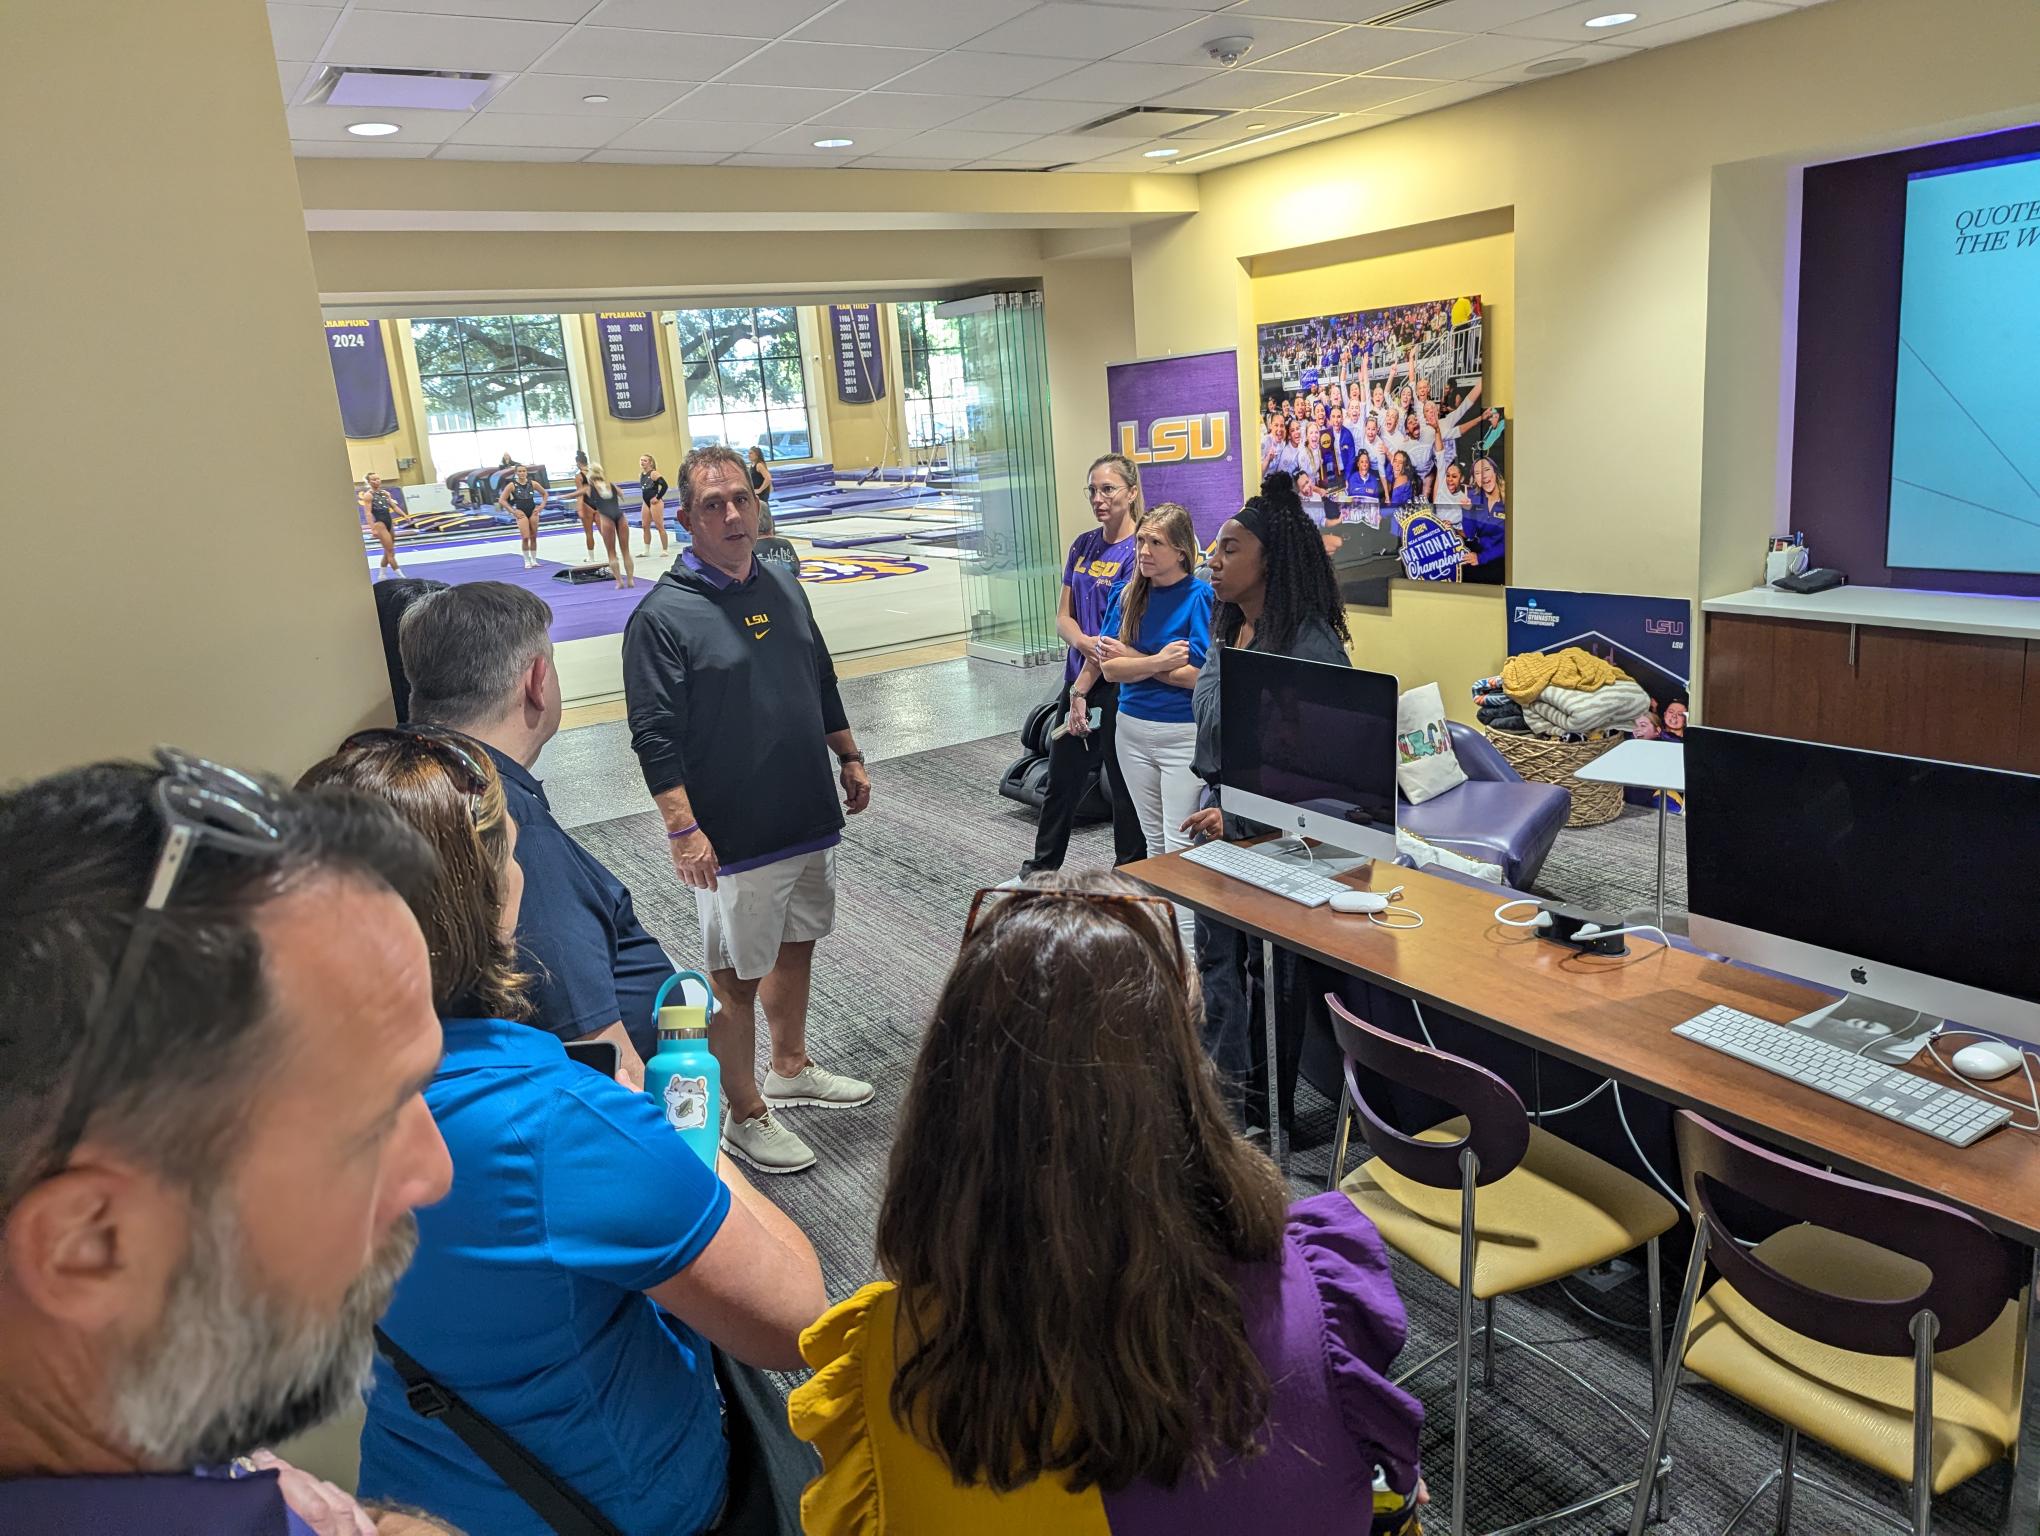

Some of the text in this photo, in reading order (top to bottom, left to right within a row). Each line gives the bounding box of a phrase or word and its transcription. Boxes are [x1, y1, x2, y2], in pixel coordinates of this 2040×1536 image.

[1955, 230, 2010, 256] THE
[332, 333, 365, 348] 2024
[1119, 412, 1229, 465] LSU
[1412, 522, 1429, 536] 2024
[1402, 530, 1461, 564] NATIONAL
[1073, 556, 1121, 578] LSU
[744, 613, 769, 627] LSU
[1645, 618, 1684, 636] LSU
[1671, 641, 1684, 649] LSU
